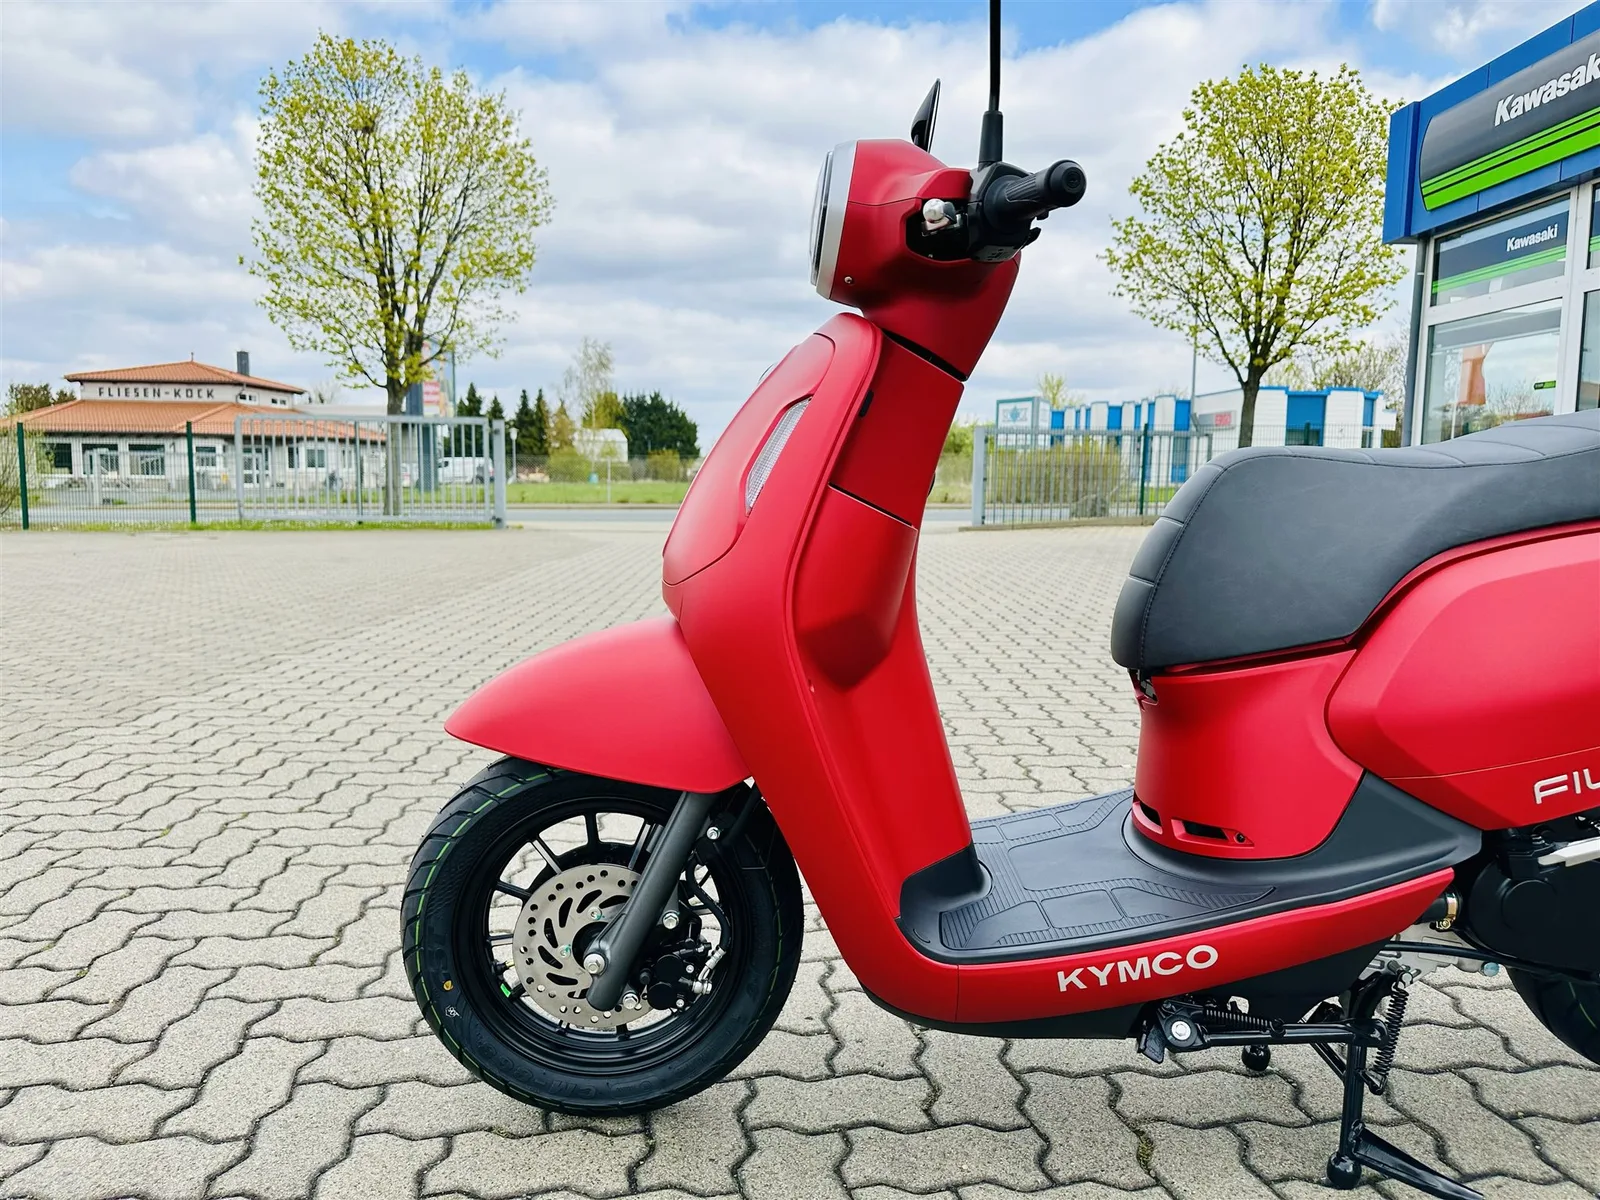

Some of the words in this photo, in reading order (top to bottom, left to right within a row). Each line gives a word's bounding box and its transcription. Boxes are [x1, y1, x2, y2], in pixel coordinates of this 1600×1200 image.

[1506, 223, 1558, 252] Kawasaki
[98, 387, 214, 399] FLIESEN-KOCK
[1057, 944, 1219, 992] KYMCO
